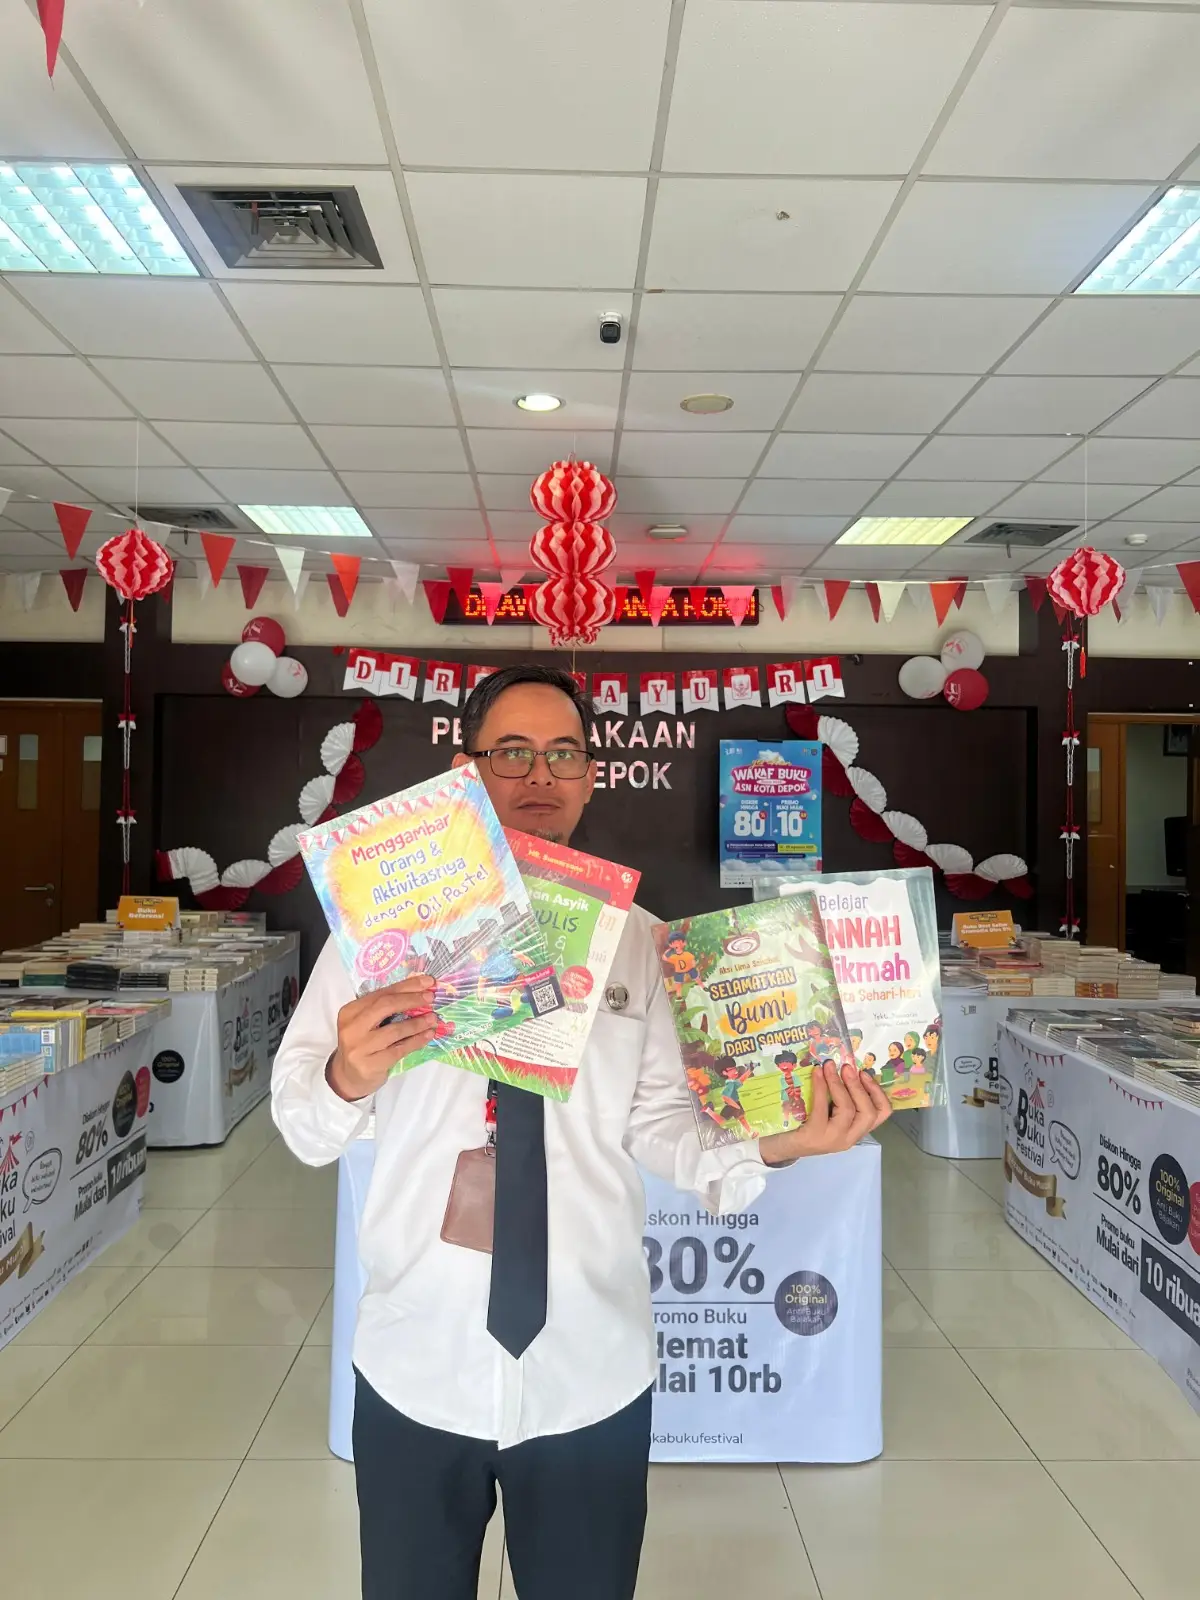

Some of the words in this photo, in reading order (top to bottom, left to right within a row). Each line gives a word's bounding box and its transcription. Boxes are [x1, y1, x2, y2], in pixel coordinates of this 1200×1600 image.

[355, 660, 707, 703] DIRAYU
[432, 716, 696, 749] PEAKAAN
[593, 760, 672, 790] EPOK
[733, 768, 774, 781] WAKAF
[778, 769, 807, 782] BUKU
[735, 784, 752, 792] ASN
[779, 783, 807, 793] DEPOK
[351, 814, 451, 866] Menggambar
[379, 851, 427, 877] Orang
[431, 841, 443, 857] &
[365, 899, 415, 928] dengan
[417, 895, 442, 920] Oil
[442, 863, 489, 902] Pastel
[552, 893, 589, 912] Asyik
[819, 894, 869, 912] Belajar
[822, 914, 902, 950] NNAH
[710, 967, 796, 999] SELAMATKAN
[831, 952, 911, 984] ikmah
[724, 991, 792, 1034] Bumi
[725, 1037, 756, 1058] DARI
[758, 1025, 808, 1049] SAMPAH
[76, 1113, 108, 1165] 80%
[1016, 1136, 1044, 1169] Festival
[1100, 1133, 1119, 1157] Diskon
[1119, 1145, 1141, 1171] Hingga
[0, 1170, 18, 1196] ka
[1097, 1154, 1141, 1215] 80%
[1155, 1180, 1185, 1208] Original
[1160, 1168, 1180, 1192] 100%
[0, 1196, 16, 1222] ku
[643, 1209, 691, 1226] skon
[1101, 1213, 1119, 1238] Promo
[1120, 1226, 1135, 1250] buku
[1096, 1225, 1120, 1261] Mulai
[1121, 1246, 1139, 1277] dari
[785, 1294, 828, 1306] Original
[791, 1284, 821, 1294] 100%
[1145, 1257, 1163, 1292] 10
[1165, 1274, 1200, 1329] ribua
[653, 1309, 698, 1324] romo
[704, 1308, 747, 1324] Buku
[651, 1364, 696, 1393] lai
[708, 1364, 782, 1393] 10rb
[651, 1433, 743, 1444] kabukufestival
